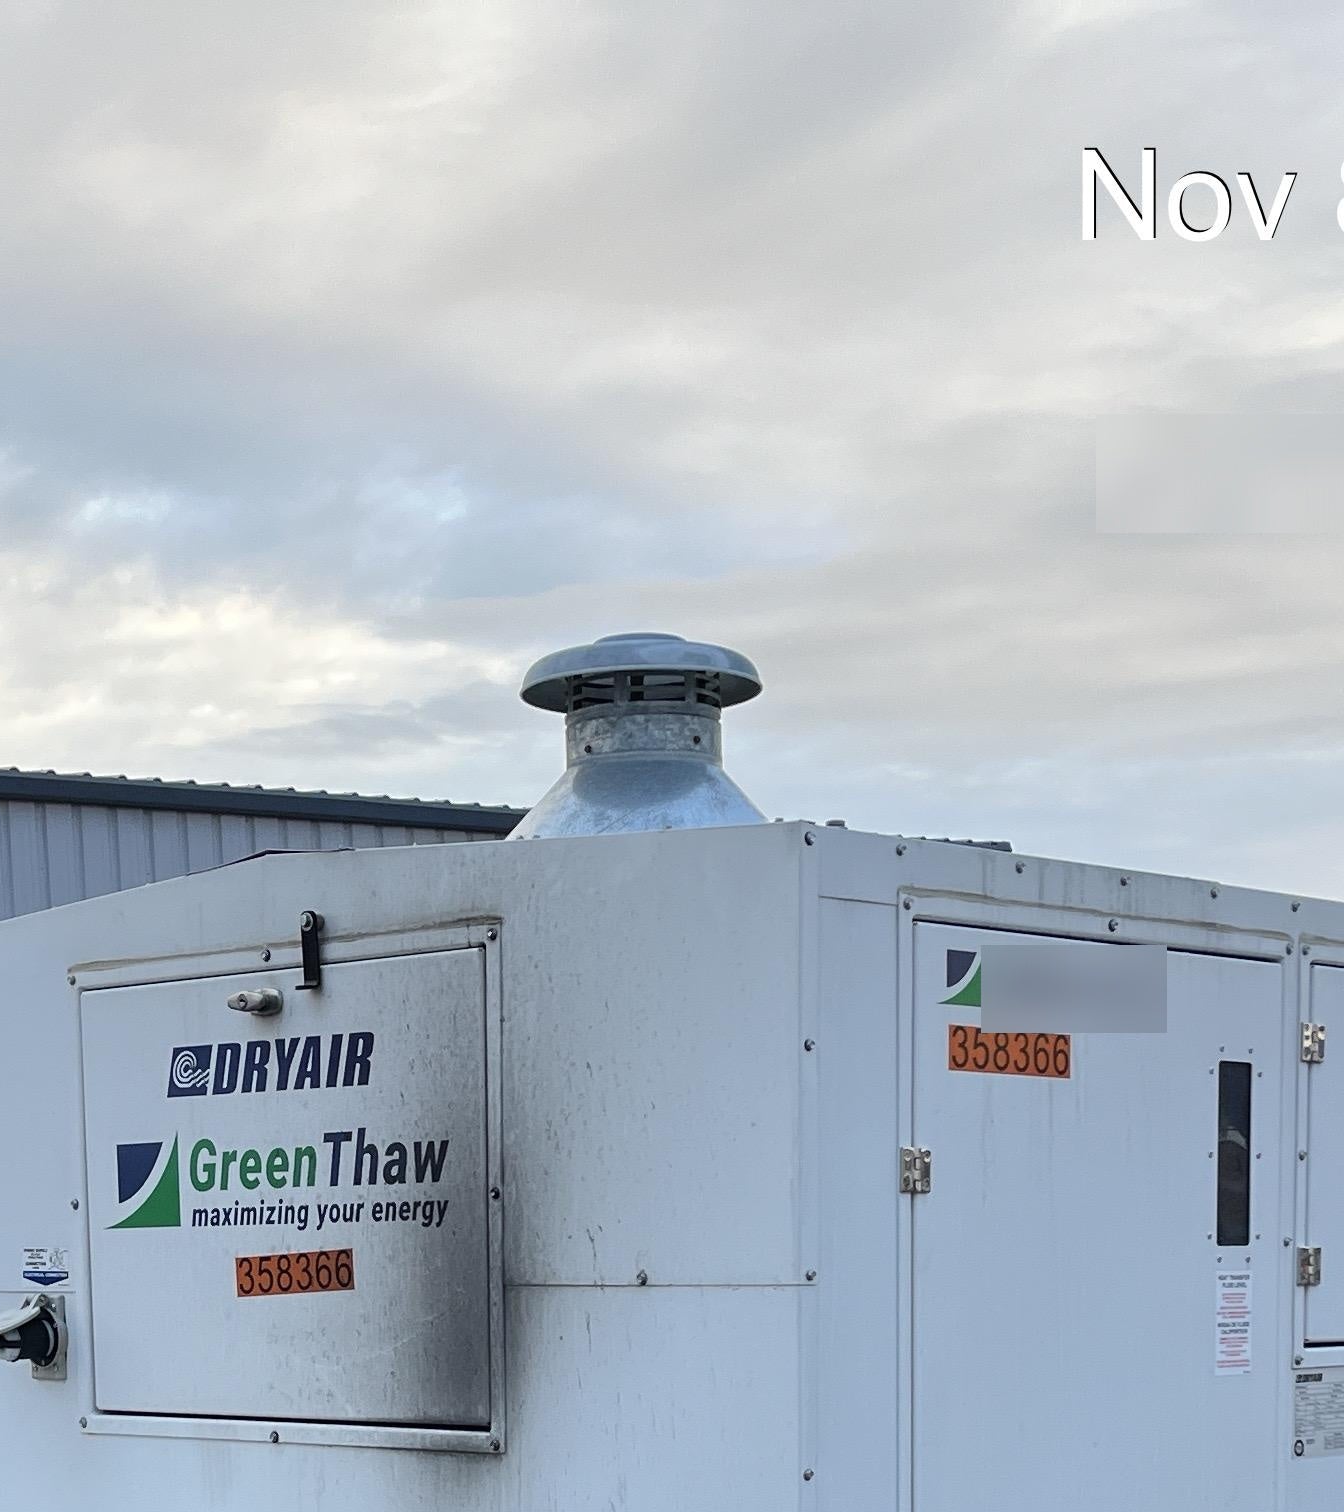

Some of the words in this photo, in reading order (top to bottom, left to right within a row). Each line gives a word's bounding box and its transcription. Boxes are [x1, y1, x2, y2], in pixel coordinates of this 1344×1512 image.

[212, 1031, 375, 1096] DRYAIR
[950, 1025, 1070, 1076] 358366
[189, 1128, 450, 1192] GreenThaw
[191, 1199, 308, 1231] maximizing
[316, 1203, 364, 1231] your
[371, 1199, 449, 1228] energy
[238, 1248, 353, 1296] 358366
